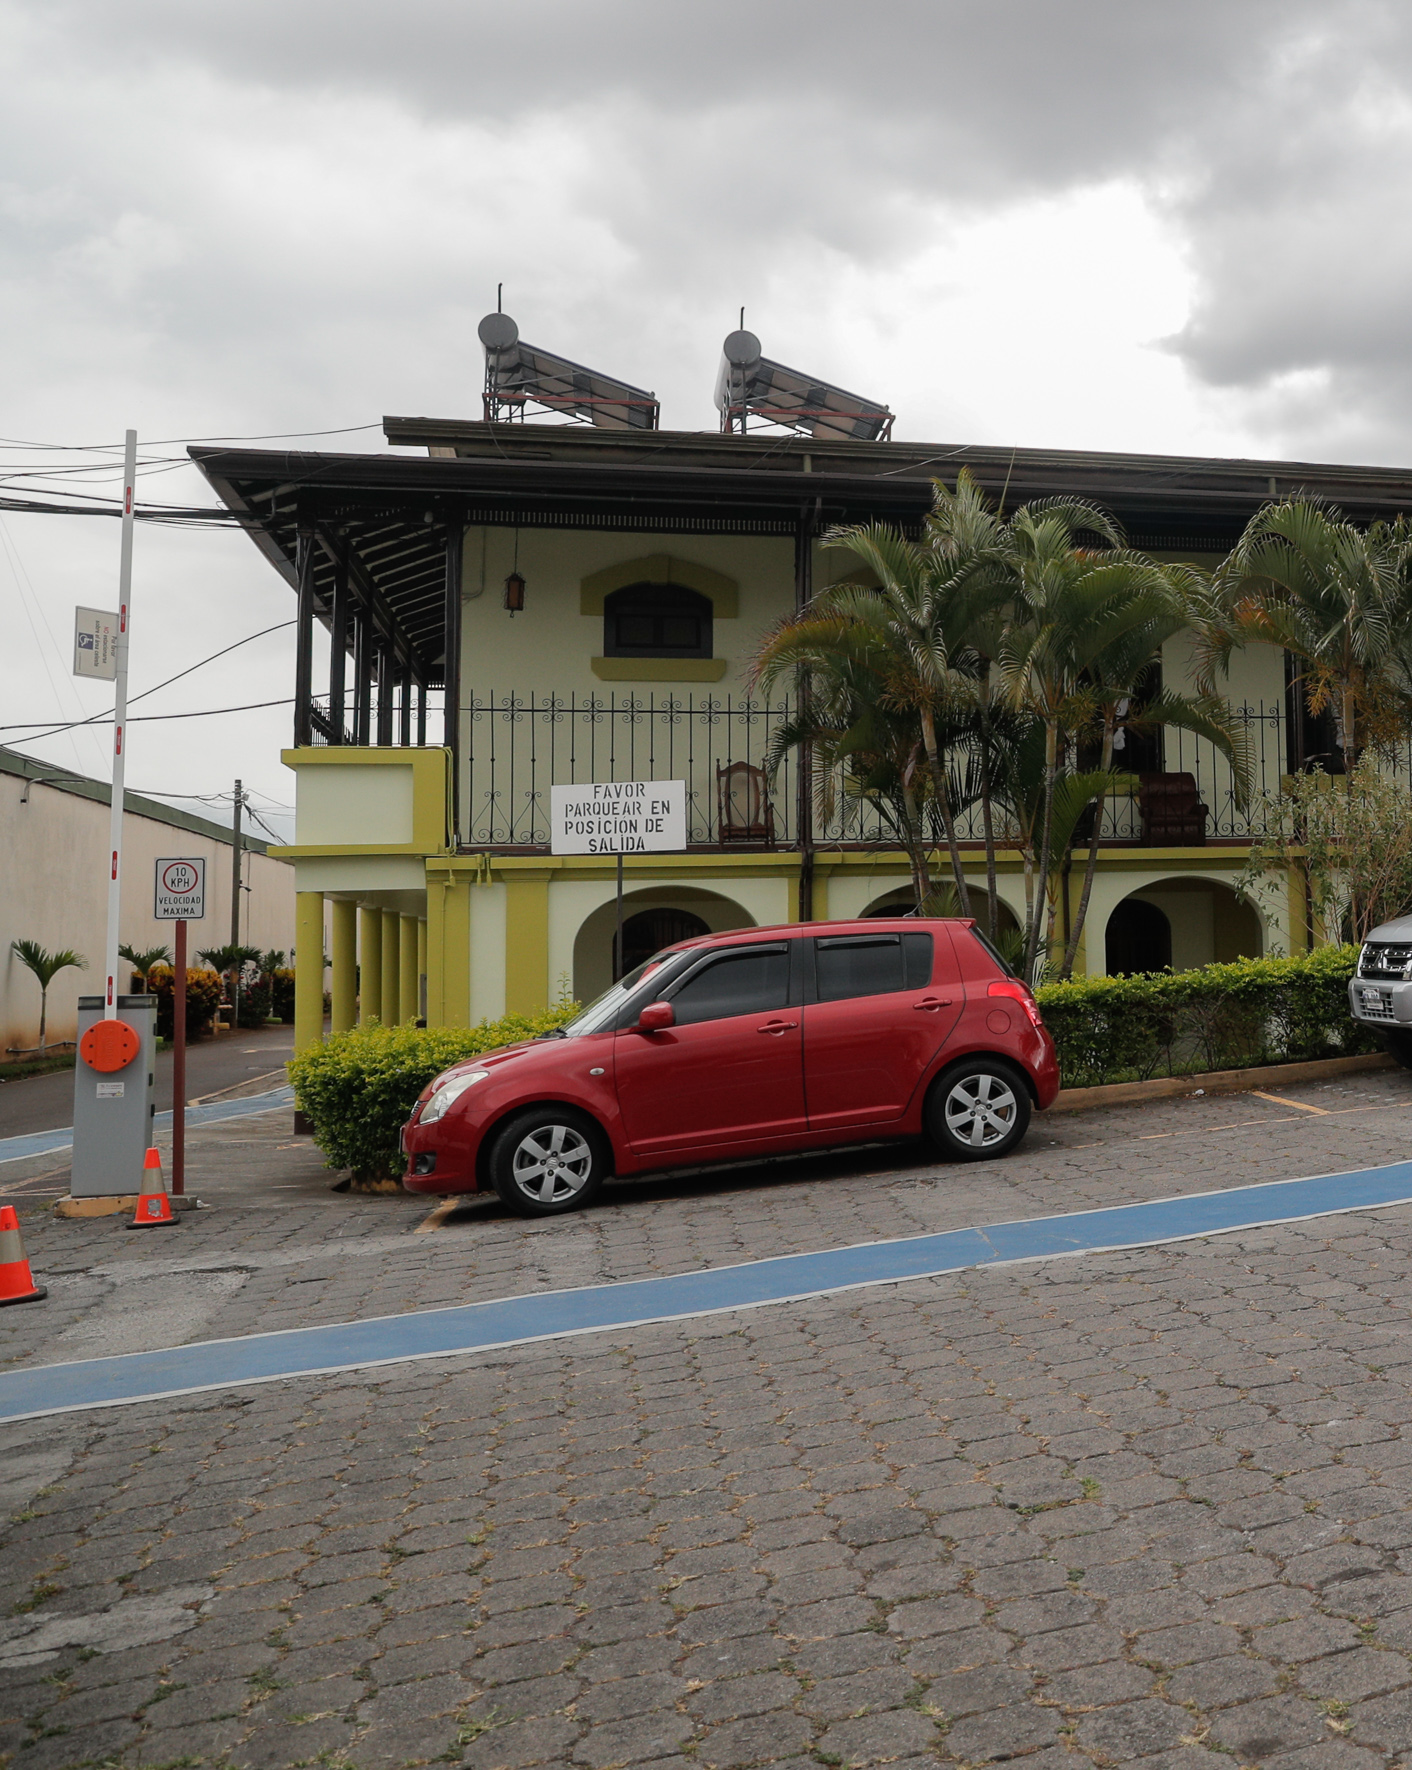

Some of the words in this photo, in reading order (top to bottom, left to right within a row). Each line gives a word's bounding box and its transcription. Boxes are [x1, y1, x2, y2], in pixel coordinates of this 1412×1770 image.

[103, 626, 109, 634] NO
[593, 783, 646, 799] FAVOR
[565, 801, 642, 818] PARQUEAR
[651, 800, 670, 815] EN
[645, 818, 664, 833] DE
[176, 867, 187, 877] 10
[170, 878, 190, 888] KPH
[158, 896, 201, 905] VELOCIDAD
[163, 907, 195, 915] MAXIMA
